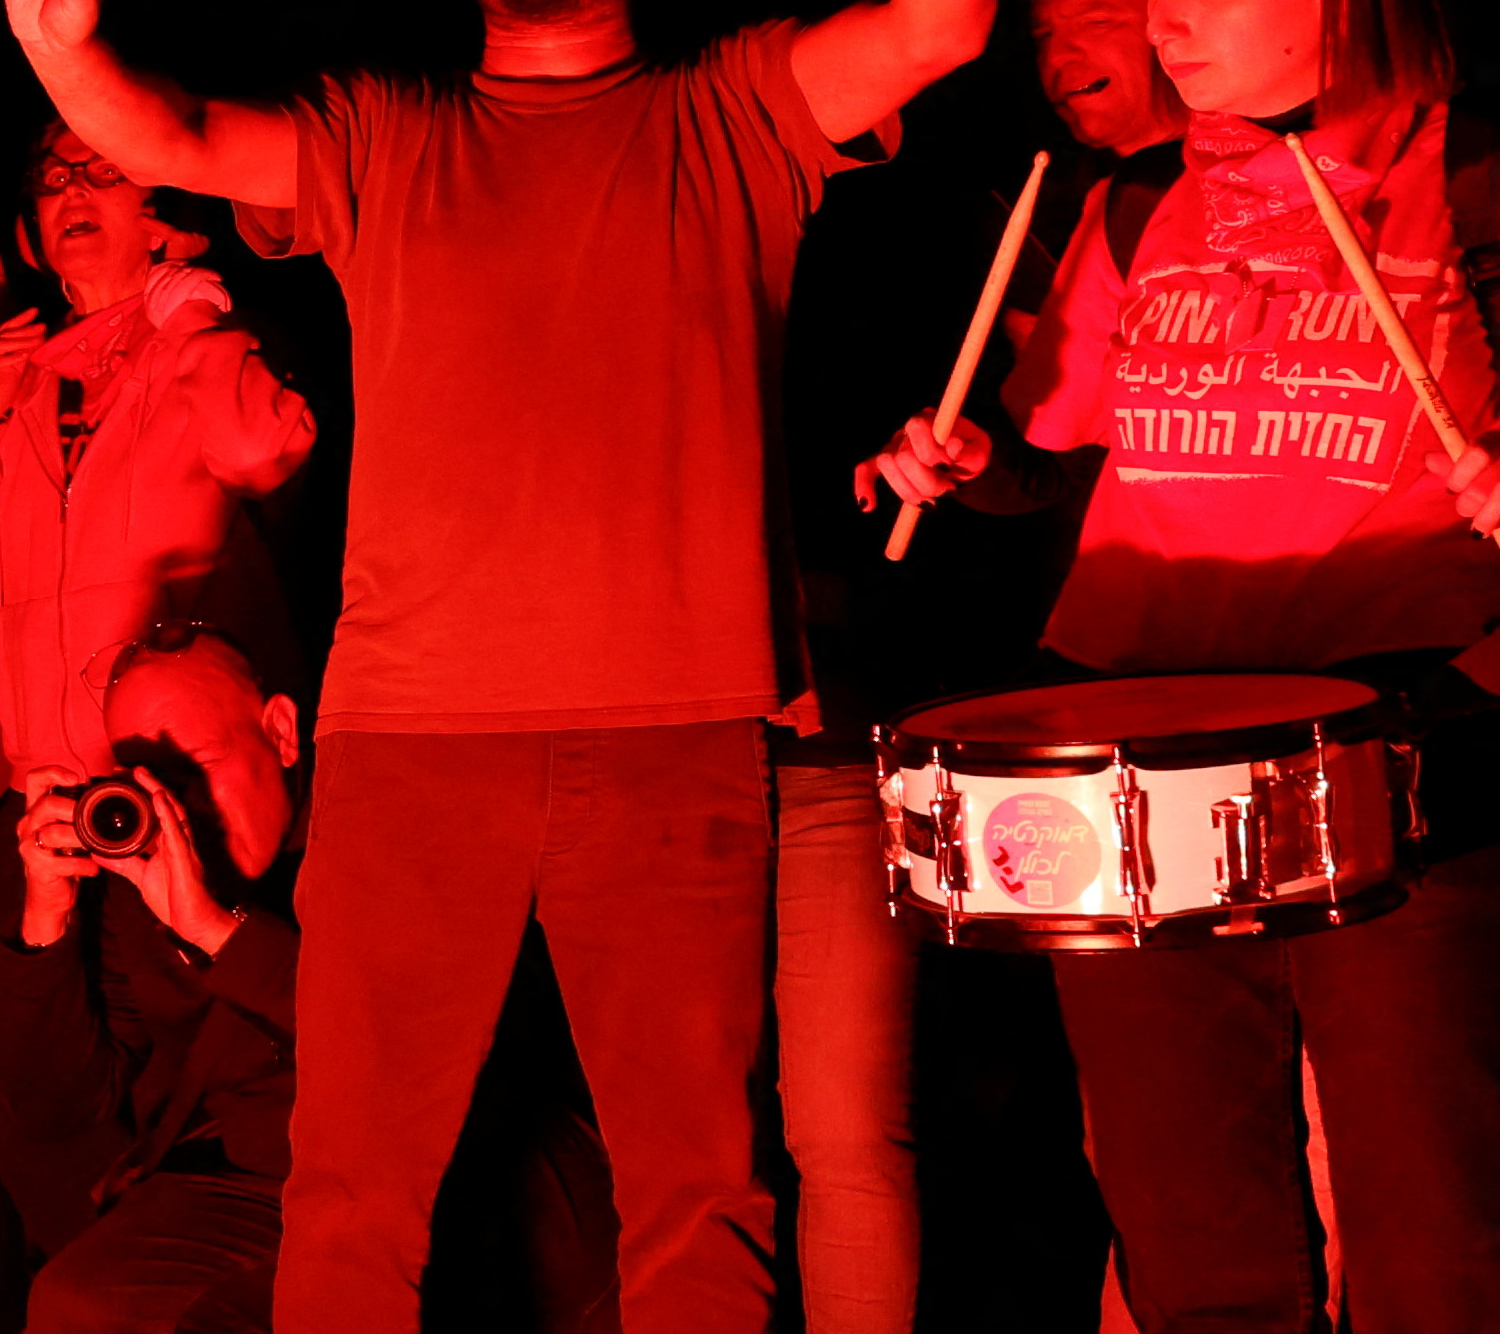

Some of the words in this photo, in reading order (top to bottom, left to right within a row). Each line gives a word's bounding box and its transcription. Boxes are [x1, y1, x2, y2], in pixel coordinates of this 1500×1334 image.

[1115, 351, 1247, 400] الوردية
[1260, 352, 1404, 400] الجبهة
[1114, 408, 1237, 456] הורודה
[1250, 410, 1387, 465] החזית
